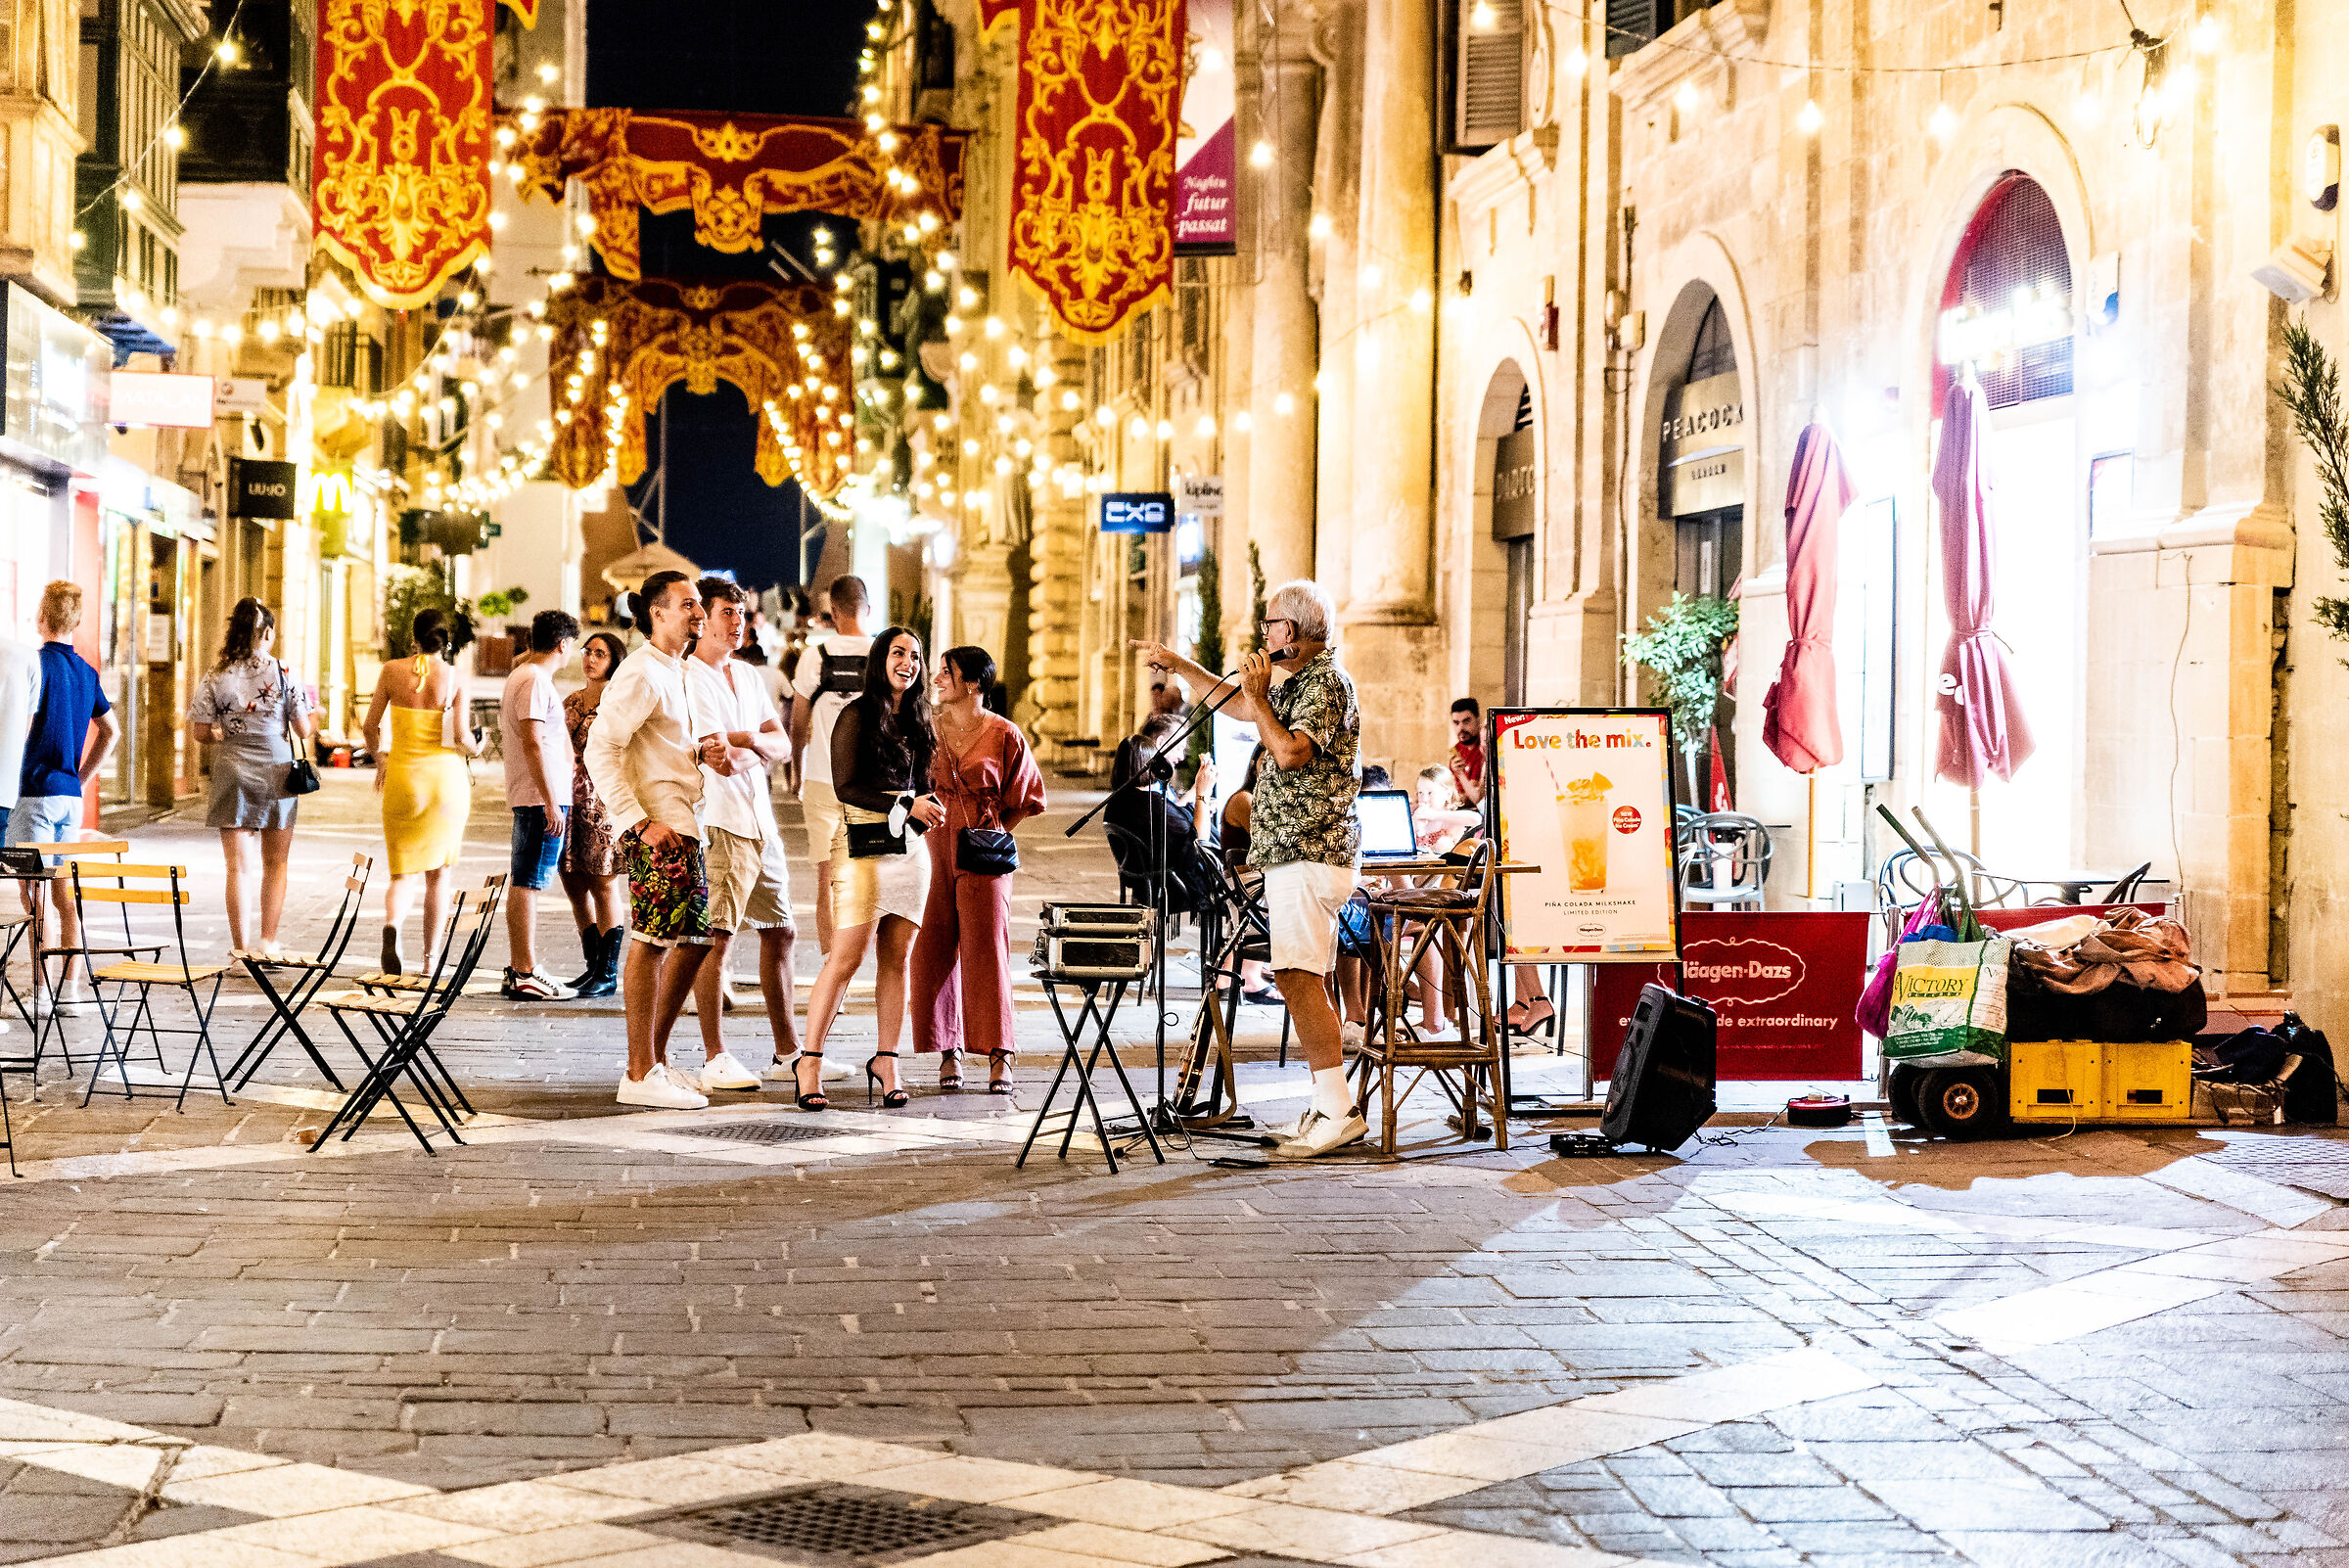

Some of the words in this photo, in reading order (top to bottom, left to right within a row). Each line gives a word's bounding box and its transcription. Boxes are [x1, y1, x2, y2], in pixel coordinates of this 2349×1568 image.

[1181, 191, 1228, 216] futur
[1503, 715, 1526, 725] New!
[1513, 729, 1562, 749] Love
[1566, 728, 1601, 749] the
[1606, 728, 1651, 748] mix.
[1894, 971, 1969, 1001] VICTORY
[1737, 1012, 1838, 1030] extraordinary
